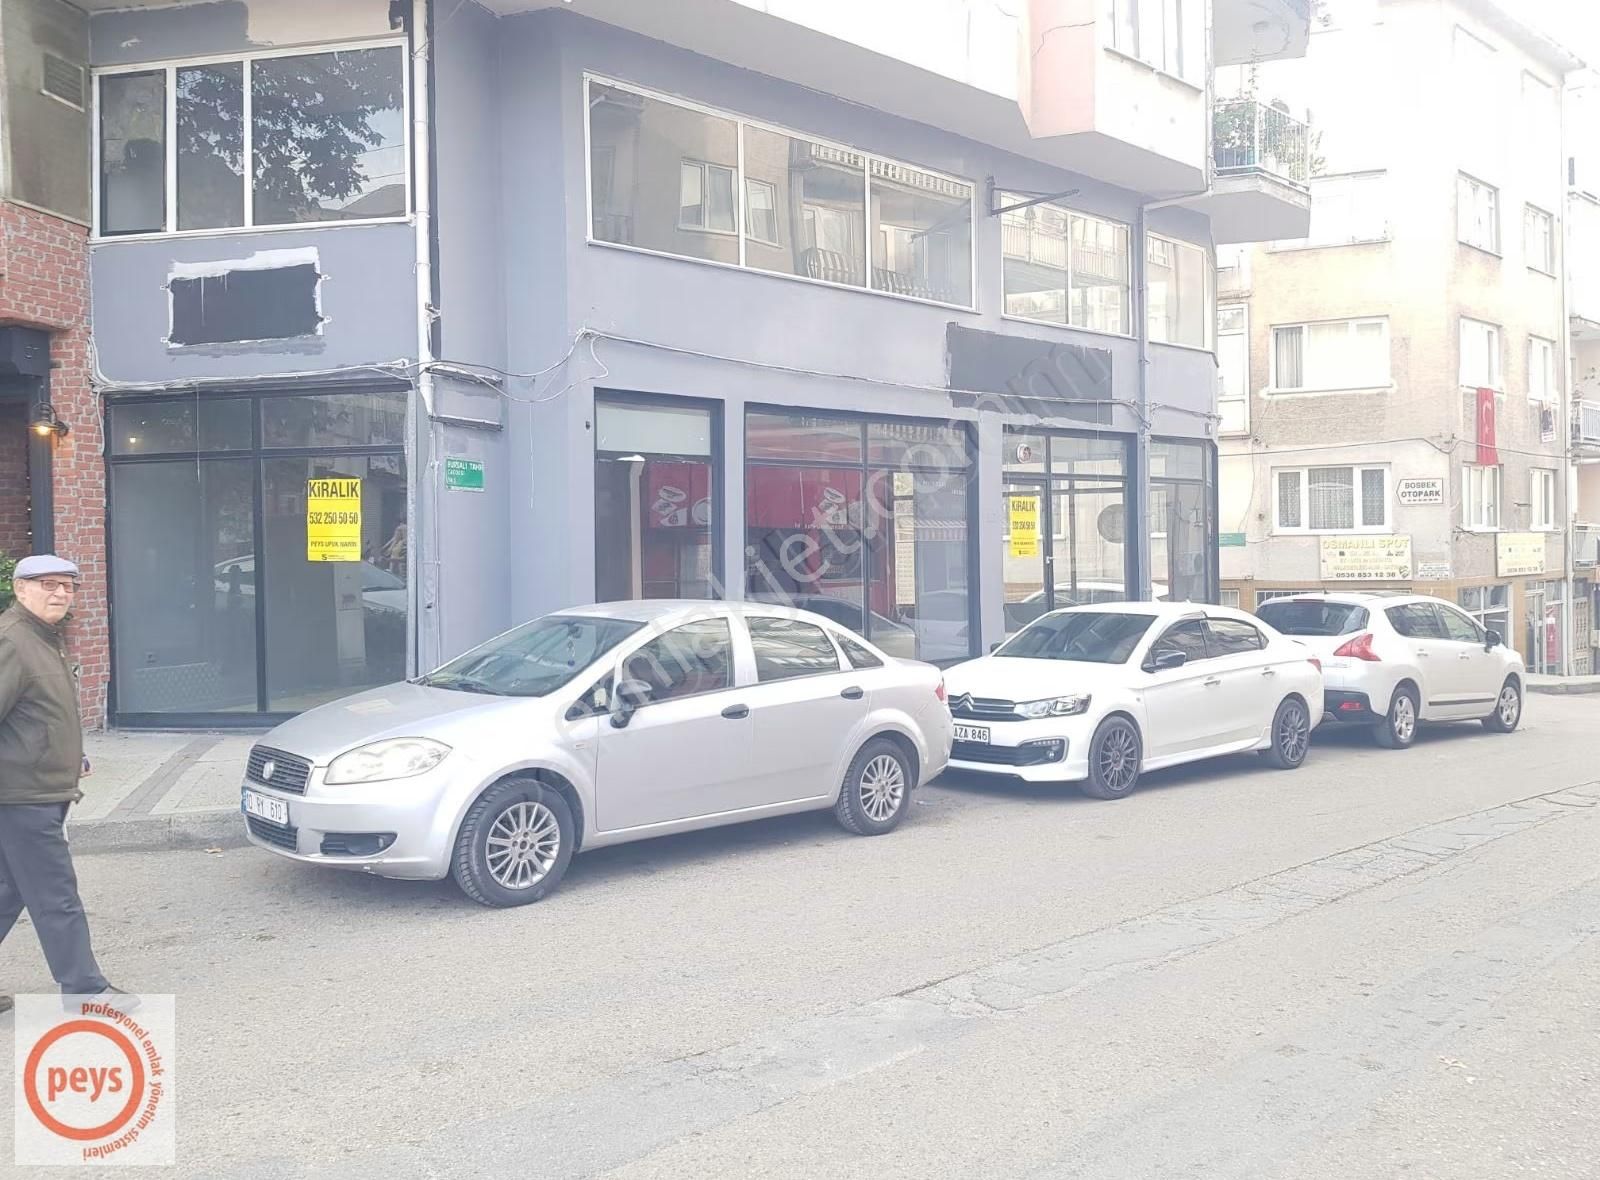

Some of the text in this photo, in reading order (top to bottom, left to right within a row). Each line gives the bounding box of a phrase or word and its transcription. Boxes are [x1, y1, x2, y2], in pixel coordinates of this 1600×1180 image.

[1400, 490, 1441, 498] OTOPARK
[309, 512, 359, 525] 532 250 50 50
[1323, 538, 1410, 550] OSMANLI SPOT
[953, 726, 988, 741] AZA 846
